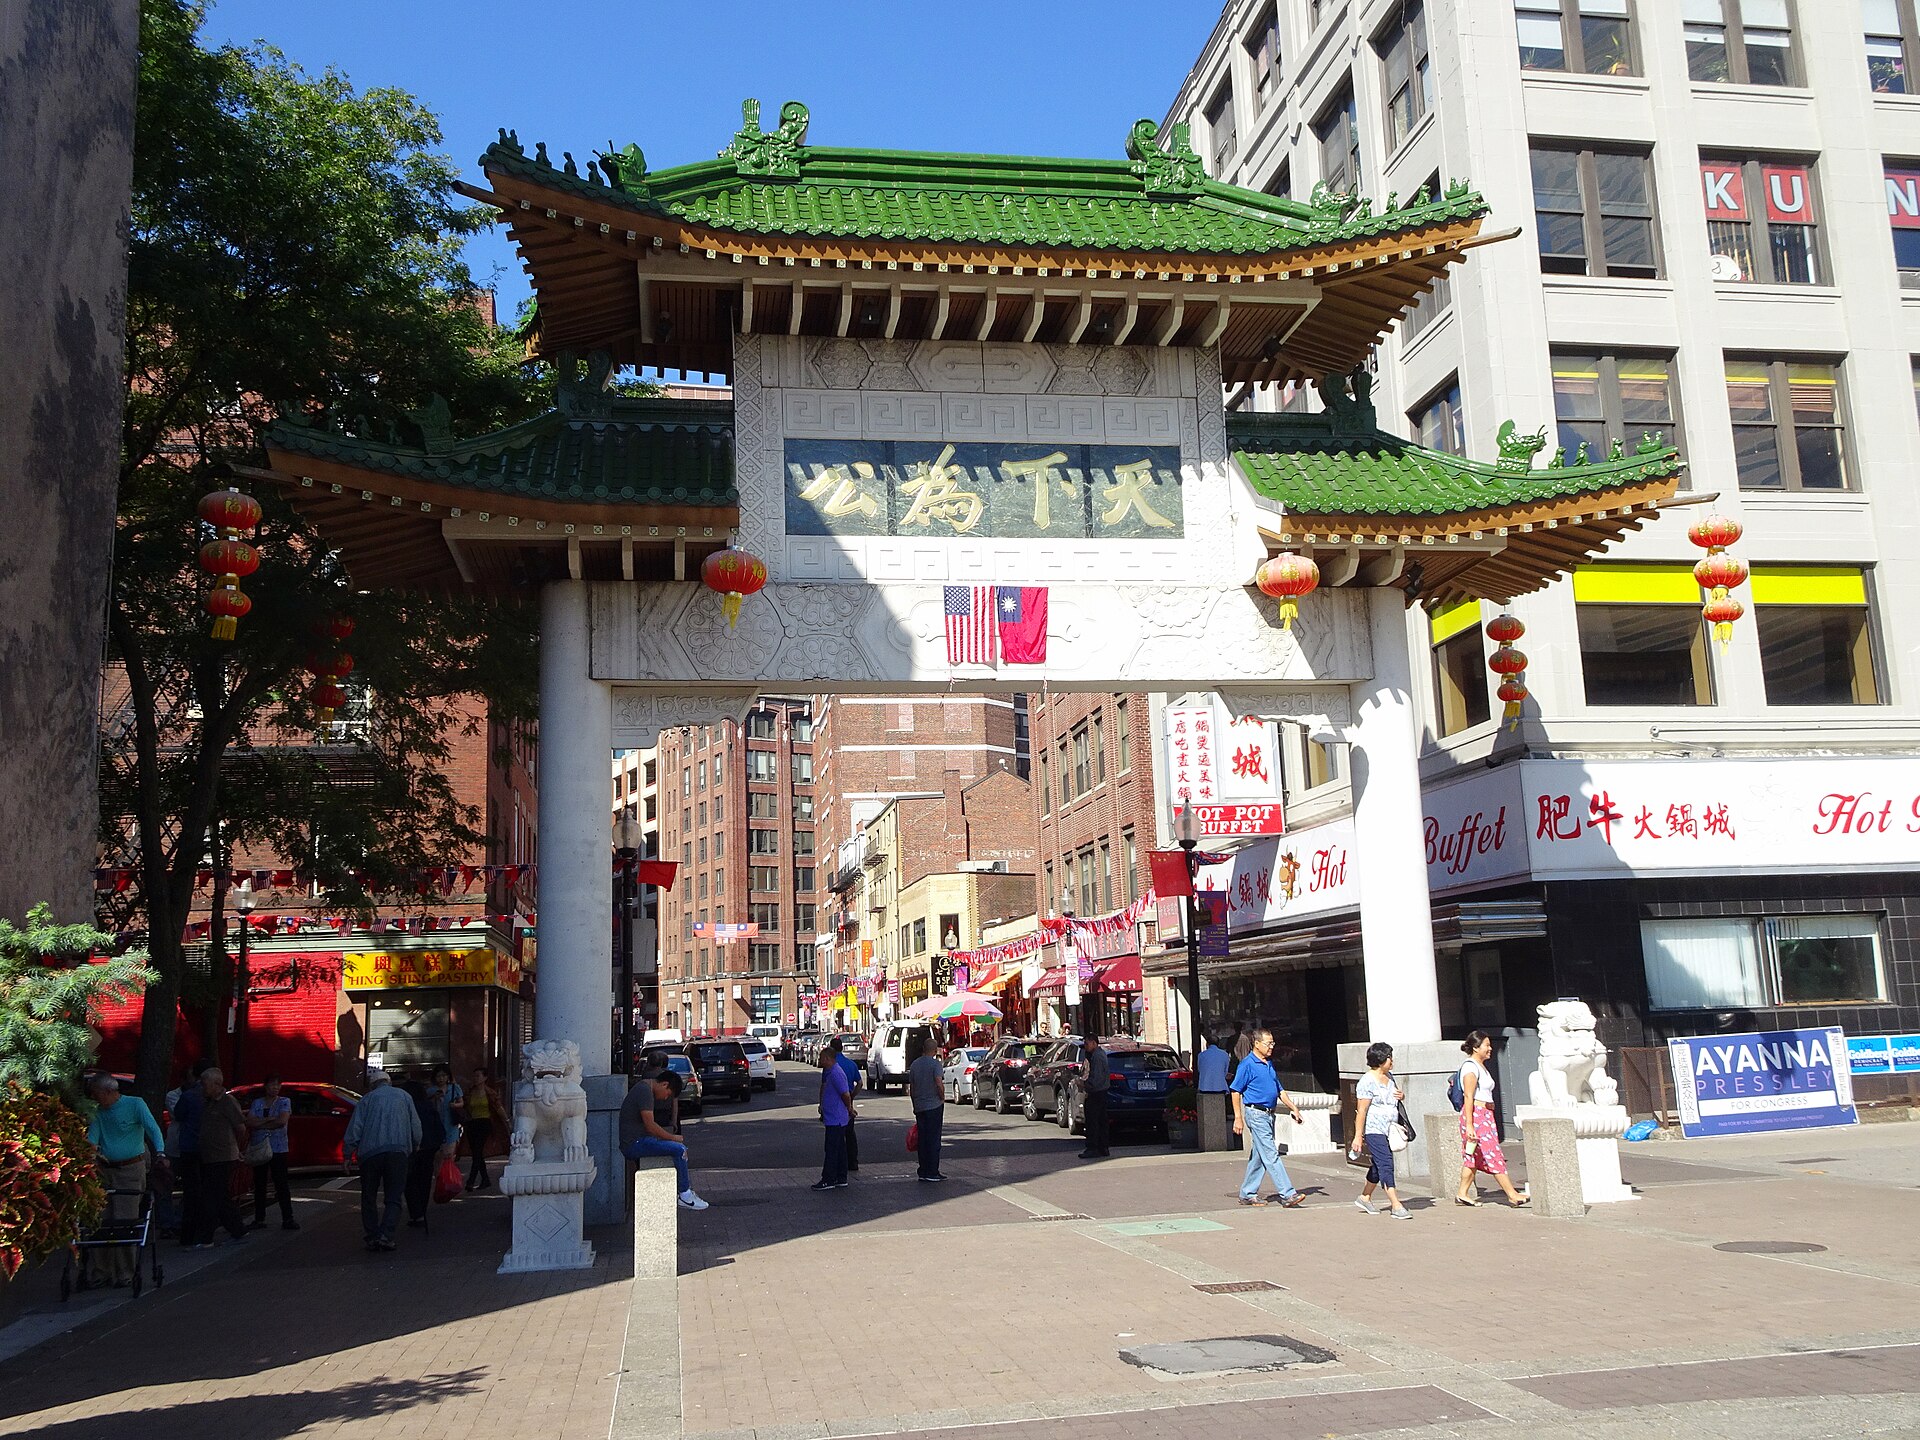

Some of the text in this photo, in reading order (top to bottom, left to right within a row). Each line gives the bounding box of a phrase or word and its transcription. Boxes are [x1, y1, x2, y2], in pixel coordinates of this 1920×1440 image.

[1235, 805, 1274, 820] POT
[1536, 790, 1736, 846] 肥牛火鍋城
[1812, 791, 1893, 835] Hot
[1422, 806, 1506, 875] Buffet
[1310, 844, 1348, 892] Hot
[350, 972, 489, 986] HING SHING PASTRY
[1695, 1039, 1831, 1076] AYANNA
[1696, 1070, 1832, 1096] PRESSLEY
[1730, 1096, 1808, 1111] FOR CONGRESS
